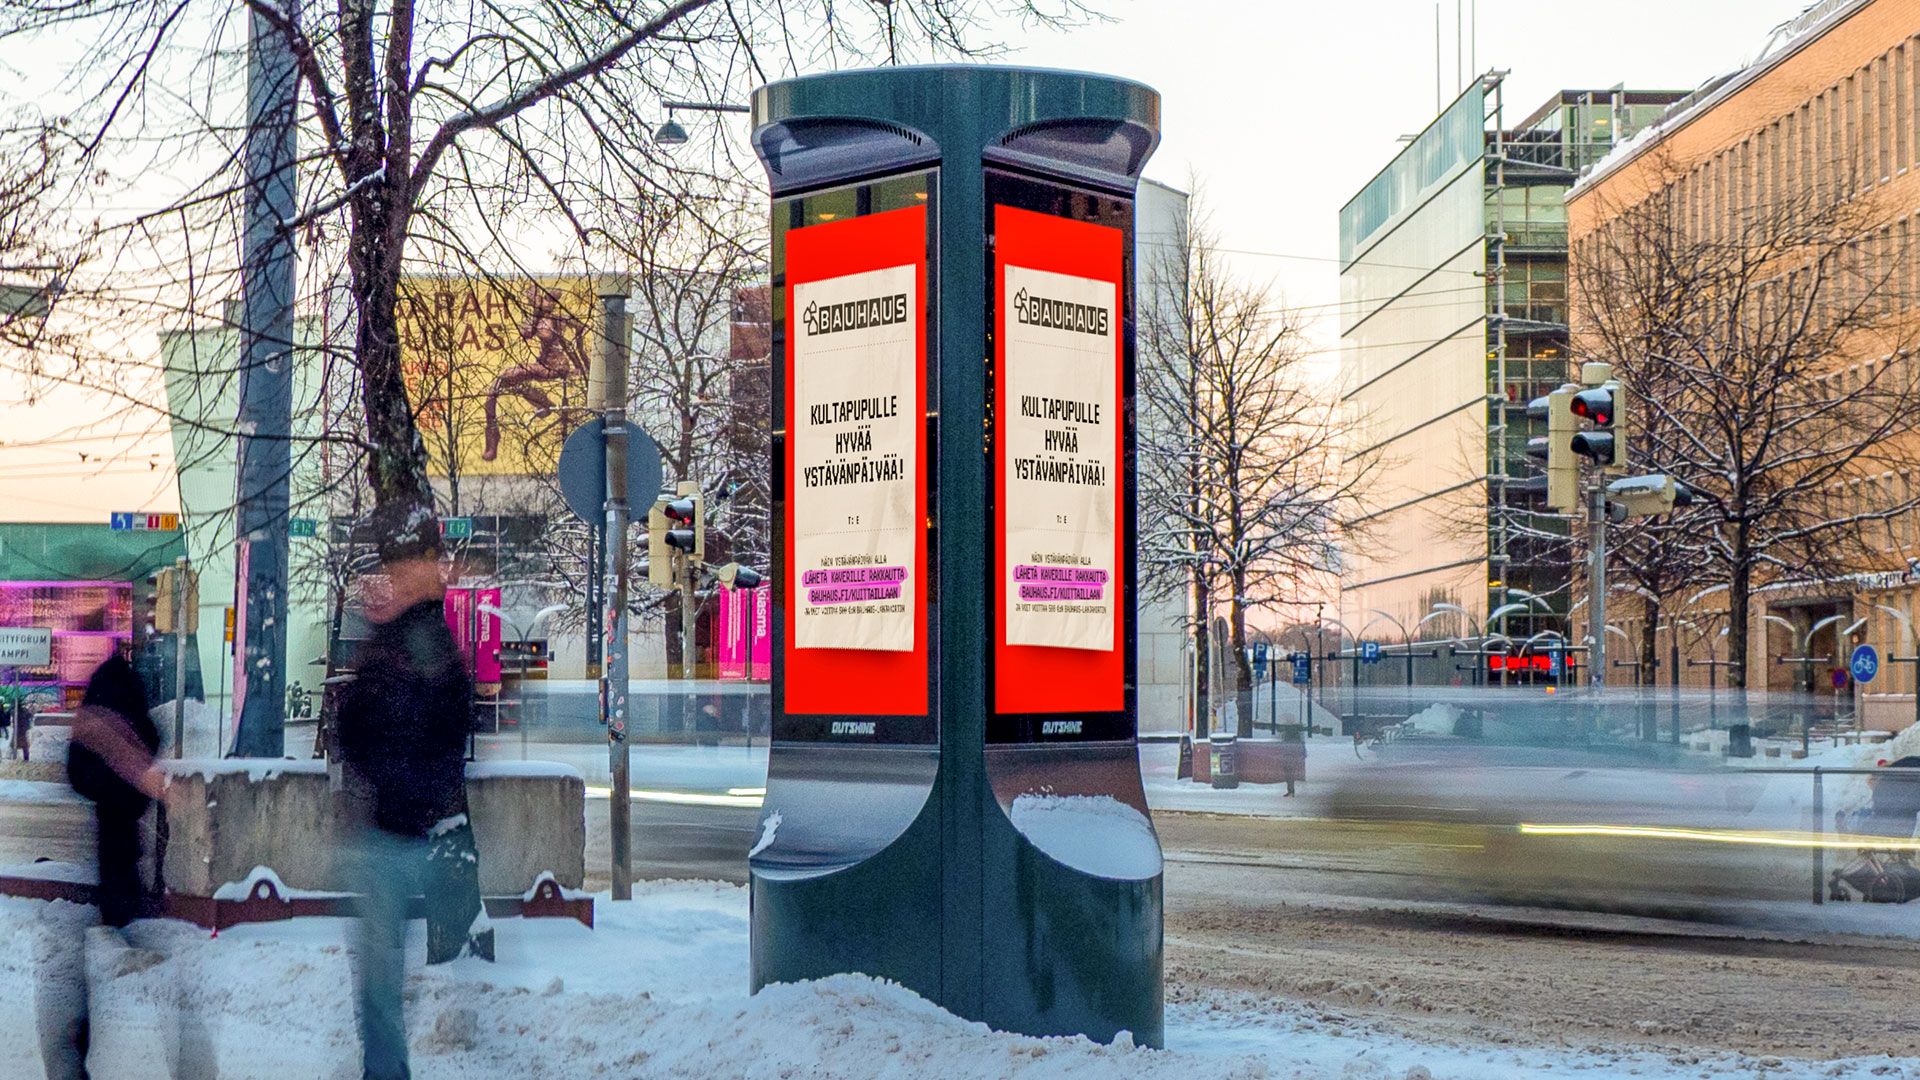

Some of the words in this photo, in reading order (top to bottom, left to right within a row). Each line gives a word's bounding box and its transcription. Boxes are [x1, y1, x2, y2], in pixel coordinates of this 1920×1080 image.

[394, 291, 509, 320] ARAH
[819, 294, 907, 334] BAUHAUS
[1029, 296, 1108, 335] BAUHAUS
[404, 323, 505, 351] UCAS
[811, 395, 897, 425] KULTAPUPULLE
[1022, 395, 1100, 425] KULTAPUPULLE
[836, 424, 872, 454] HYVÄÄ
[1045, 426, 1078, 453] HYVÄÄ
[804, 453, 903, 487] YSTÄVÄNPÄIVÄÄ!
[1015, 454, 1105, 486] YSTÄVÄNPÄIVÄÄ!
[805, 569, 828, 584] LÄHETÄ
[831, 570, 865, 583] KAVERILLE
[869, 568, 905, 582] RAKKAUTTA
[1015, 564, 1038, 580] LÄHETÄ
[1040, 568, 1072, 582] KAVERILLE
[1075, 569, 1106, 583] RAKKAUTTA
[811, 587, 898, 602] BAUHAUS.FI/KUITTAILLAAN
[1021, 586, 1100, 600] BAUHAUS.FI/KUITTAILLAAN
[481, 594, 492, 642] kasma
[0, 634, 47, 644] ITYFORUM
[1256, 644, 1266, 655] P
[1366, 643, 1377, 658] P
[0, 649, 29, 658] AMPPI
[832, 721, 876, 734] OUTSHINE
[1042, 720, 1082, 734] OUTSHINE
